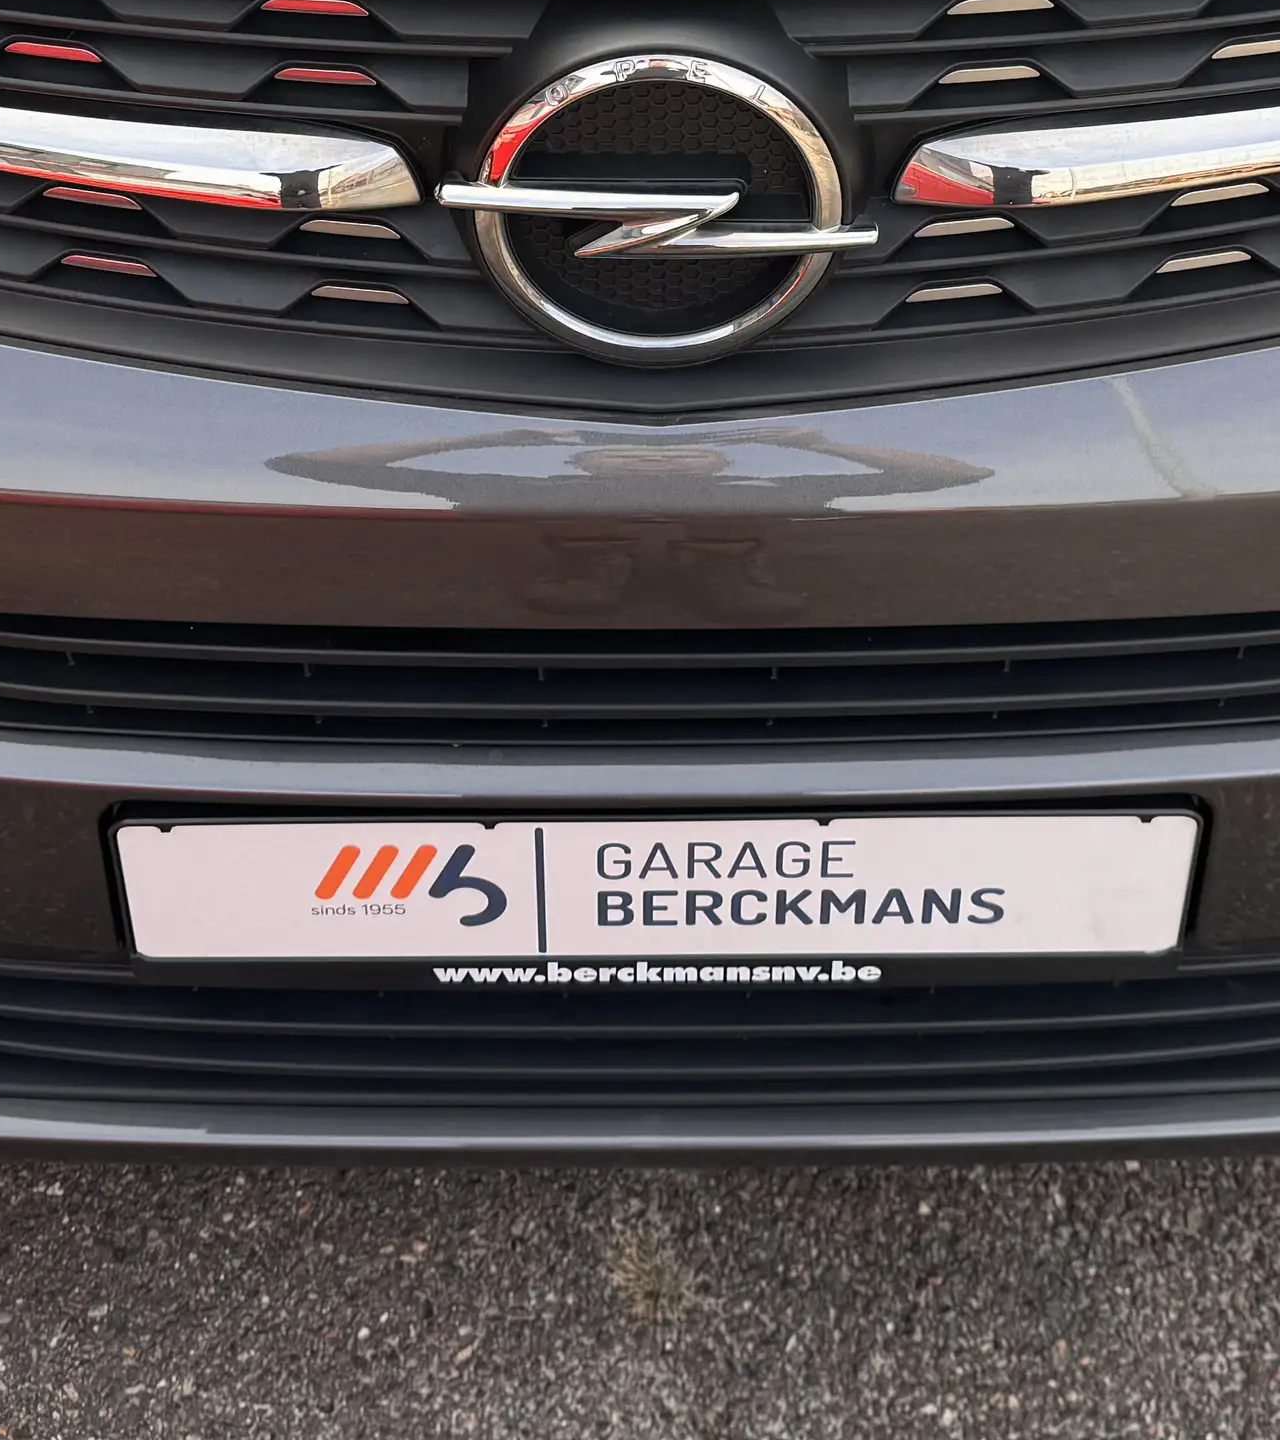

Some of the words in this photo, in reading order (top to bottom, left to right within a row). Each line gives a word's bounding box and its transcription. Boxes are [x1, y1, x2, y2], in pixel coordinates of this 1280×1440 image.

[545, 59, 767, 107] OPEL
[596, 840, 857, 880] GARAGE
[311, 904, 356, 916] sinds
[361, 904, 406, 916] 1955
[596, 887, 1006, 927] BERCKMANS
[432, 960, 883, 984] www.berckmansnv.be
